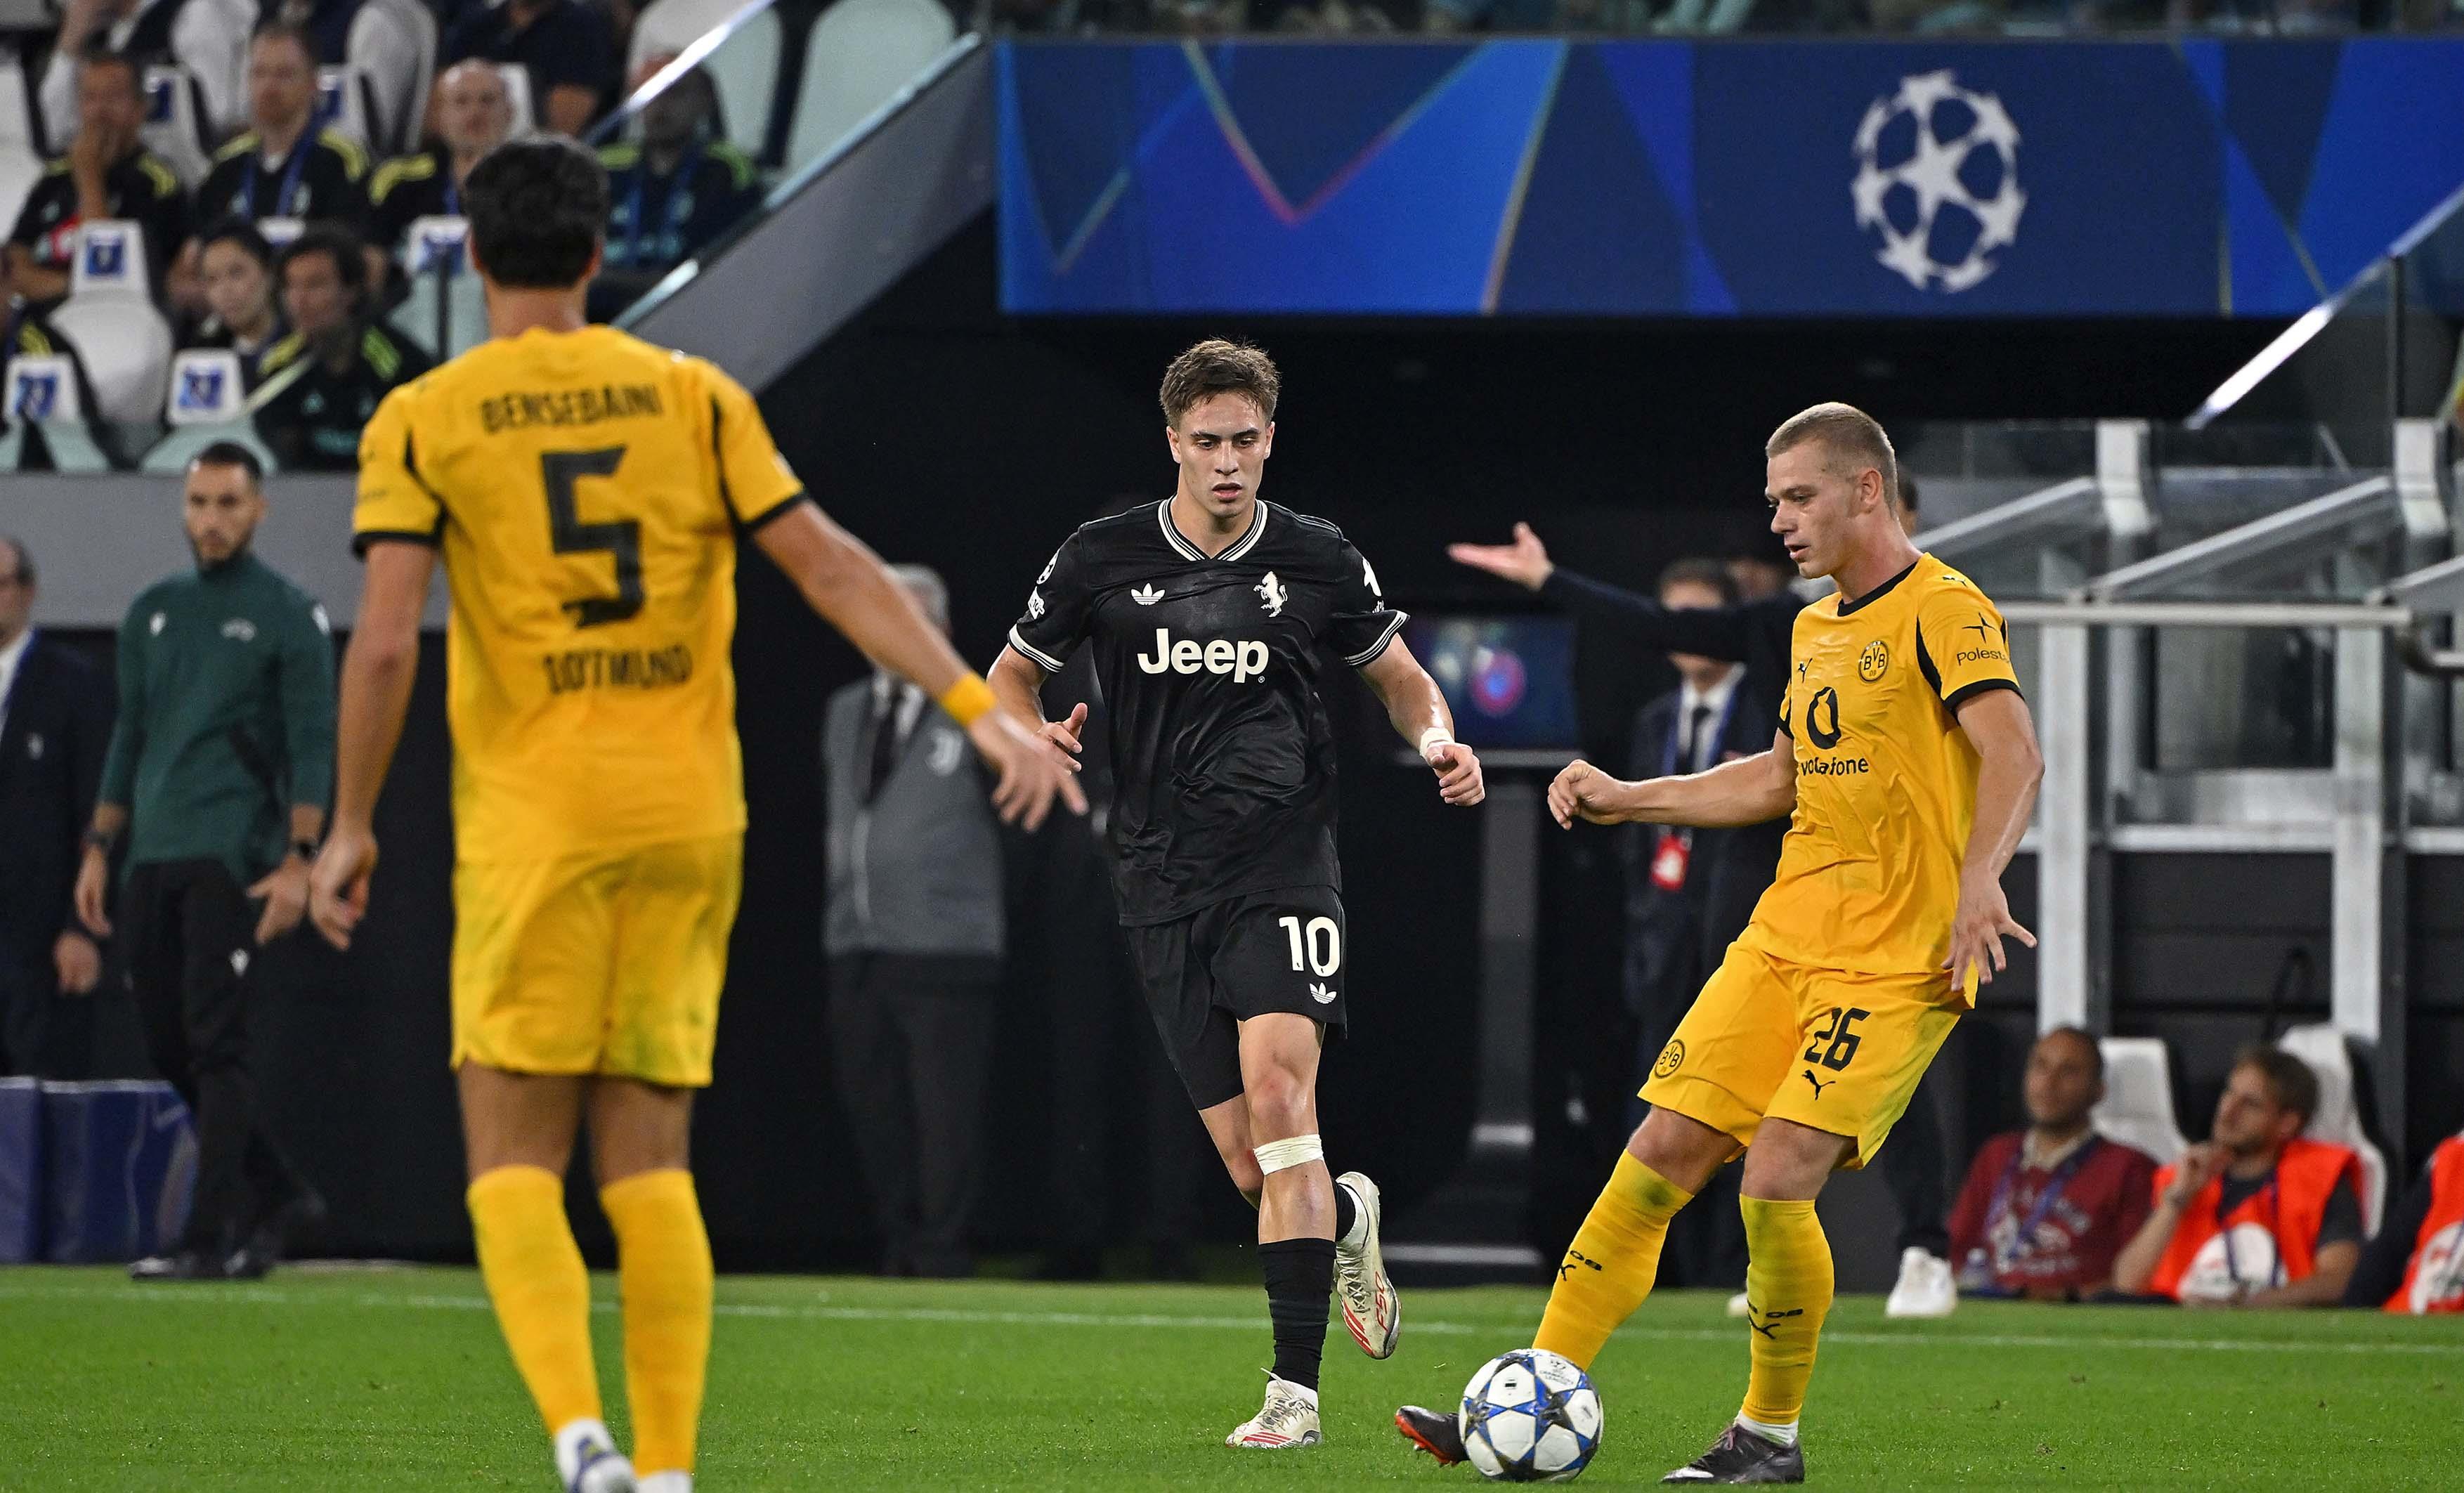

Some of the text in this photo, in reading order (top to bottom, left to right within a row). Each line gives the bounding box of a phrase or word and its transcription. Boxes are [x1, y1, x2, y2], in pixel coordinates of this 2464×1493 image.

[481, 384, 663, 435] BENSEBAINI
[540, 445, 645, 629] 5
[1137, 628, 1269, 683] Jeep
[1863, 647, 1886, 671] BVB
[1957, 646, 2009, 667] Polest
[1279, 916, 1341, 977] 10
[1659, 1045, 1680, 1067] BVB
[1804, 1007, 1871, 1071] 26
